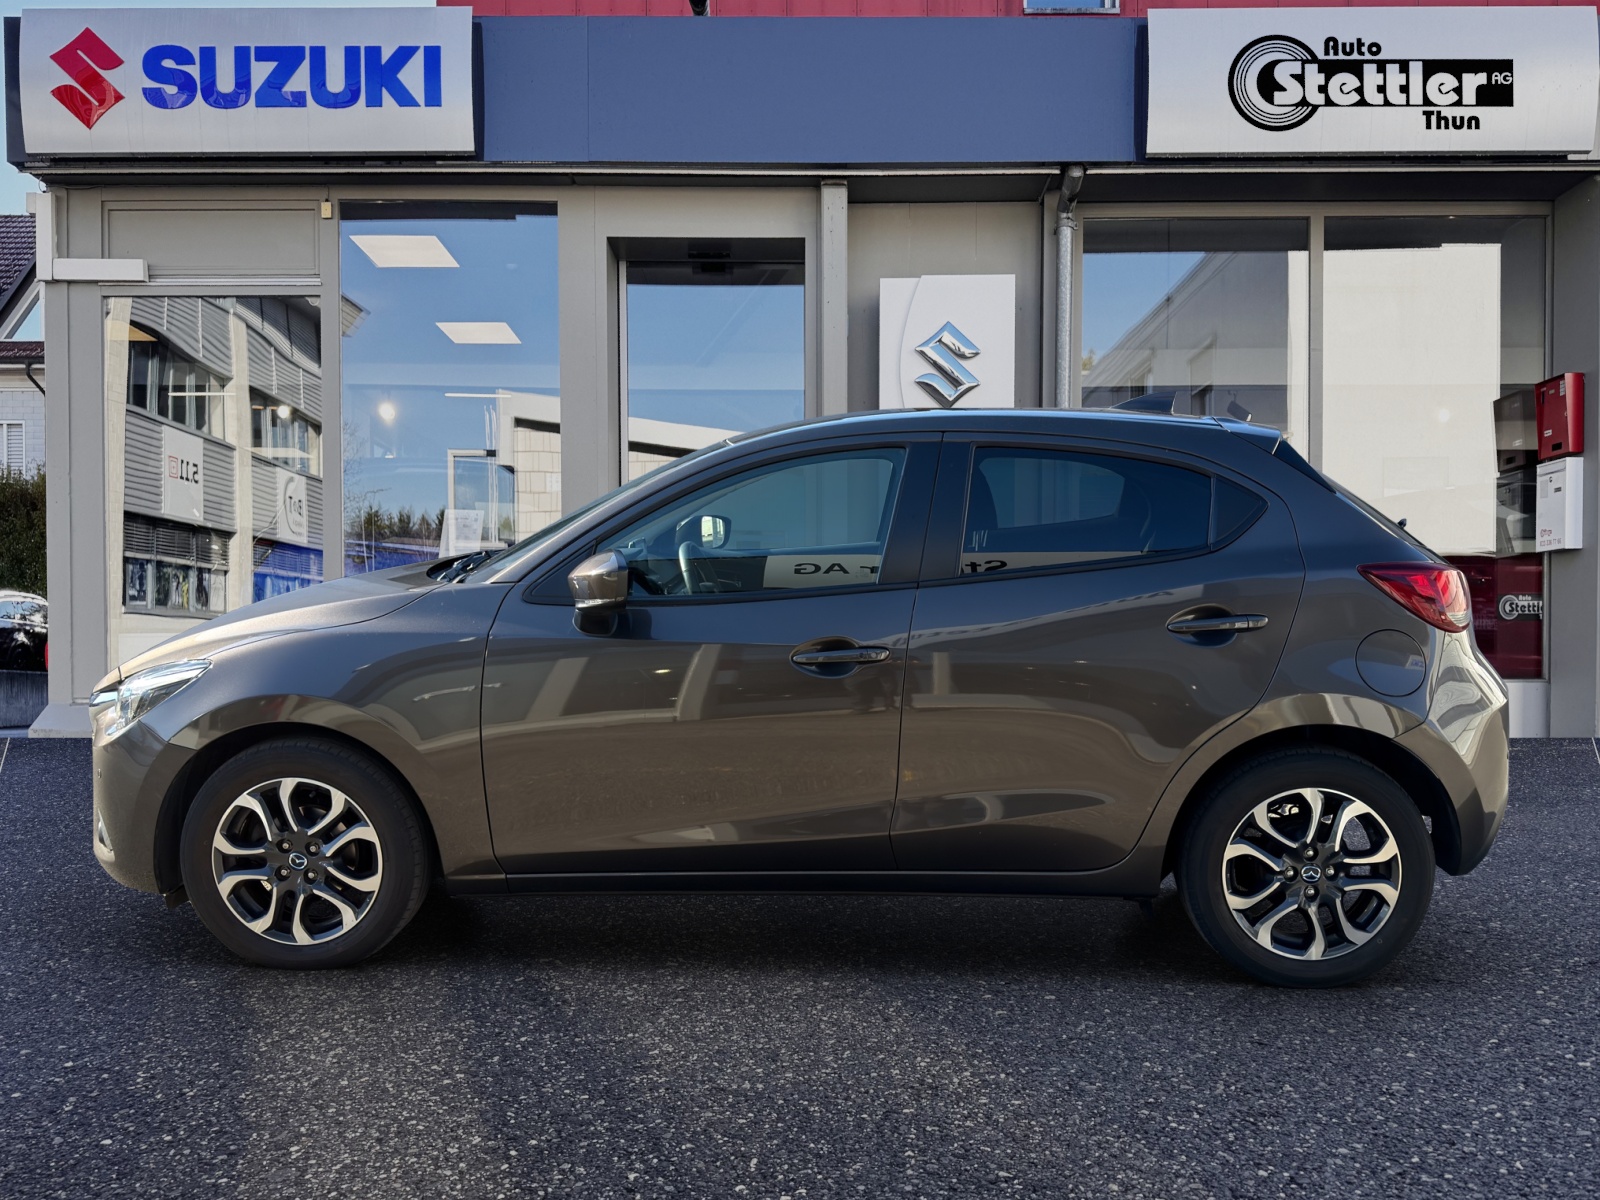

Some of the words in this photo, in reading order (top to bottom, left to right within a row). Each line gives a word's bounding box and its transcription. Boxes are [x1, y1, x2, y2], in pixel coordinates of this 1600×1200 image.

[1323, 36, 1382, 57] Auto
[141, 44, 443, 110] SUZUKI
[1273, 60, 1488, 106] Stettler
[1491, 72, 1512, 84] AG
[1422, 110, 1481, 130] Thun
[1508, 601, 1543, 613] Stettl
